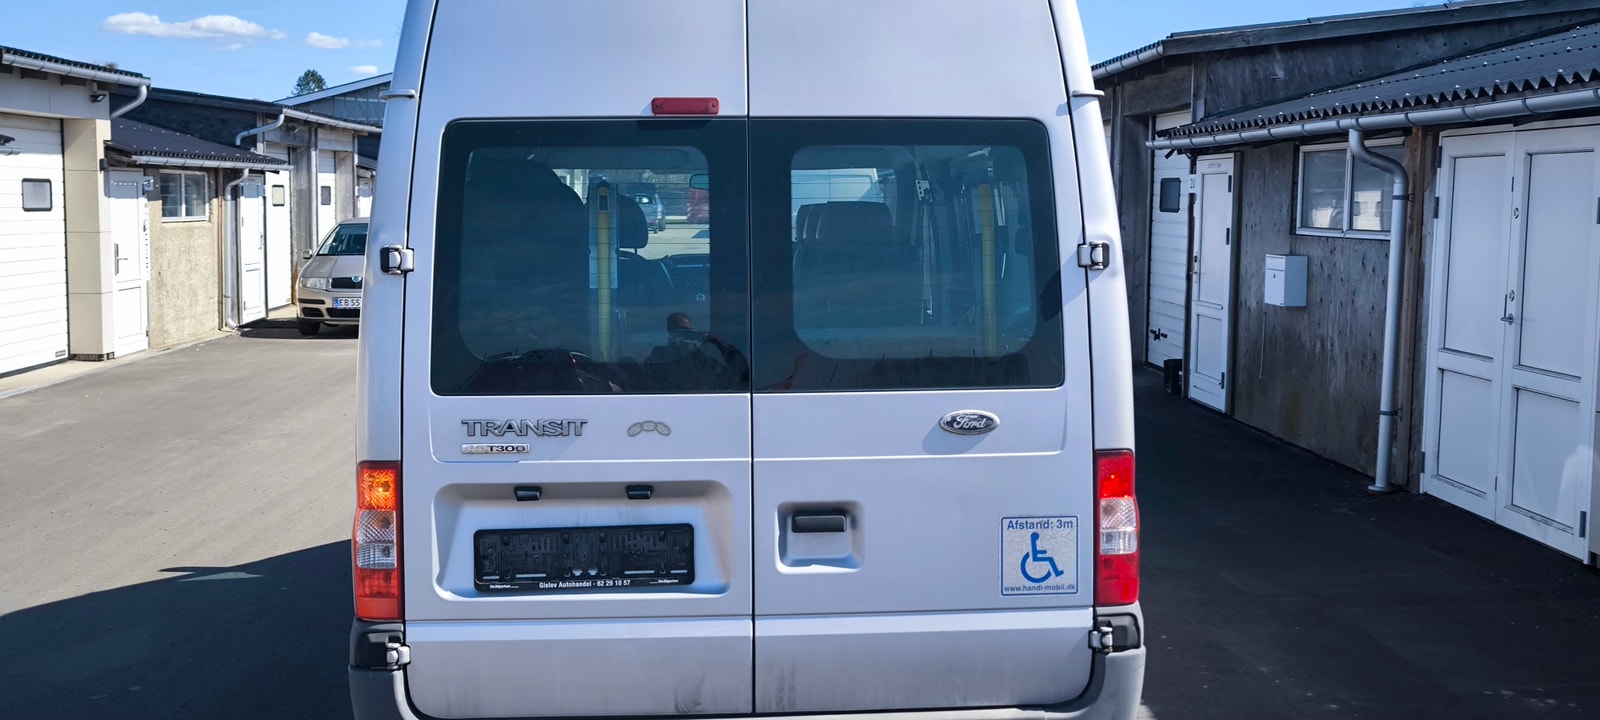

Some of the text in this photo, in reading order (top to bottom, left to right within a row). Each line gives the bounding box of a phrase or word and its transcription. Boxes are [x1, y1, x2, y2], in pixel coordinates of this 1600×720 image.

[953, 414, 987, 429] Ford
[461, 419, 588, 436] TRANSIT
[1007, 519, 1073, 530] Afstand: 3m
[558, 580, 592, 588] Autohandel
[1004, 583, 1075, 592] www.handi-mobil.dk
